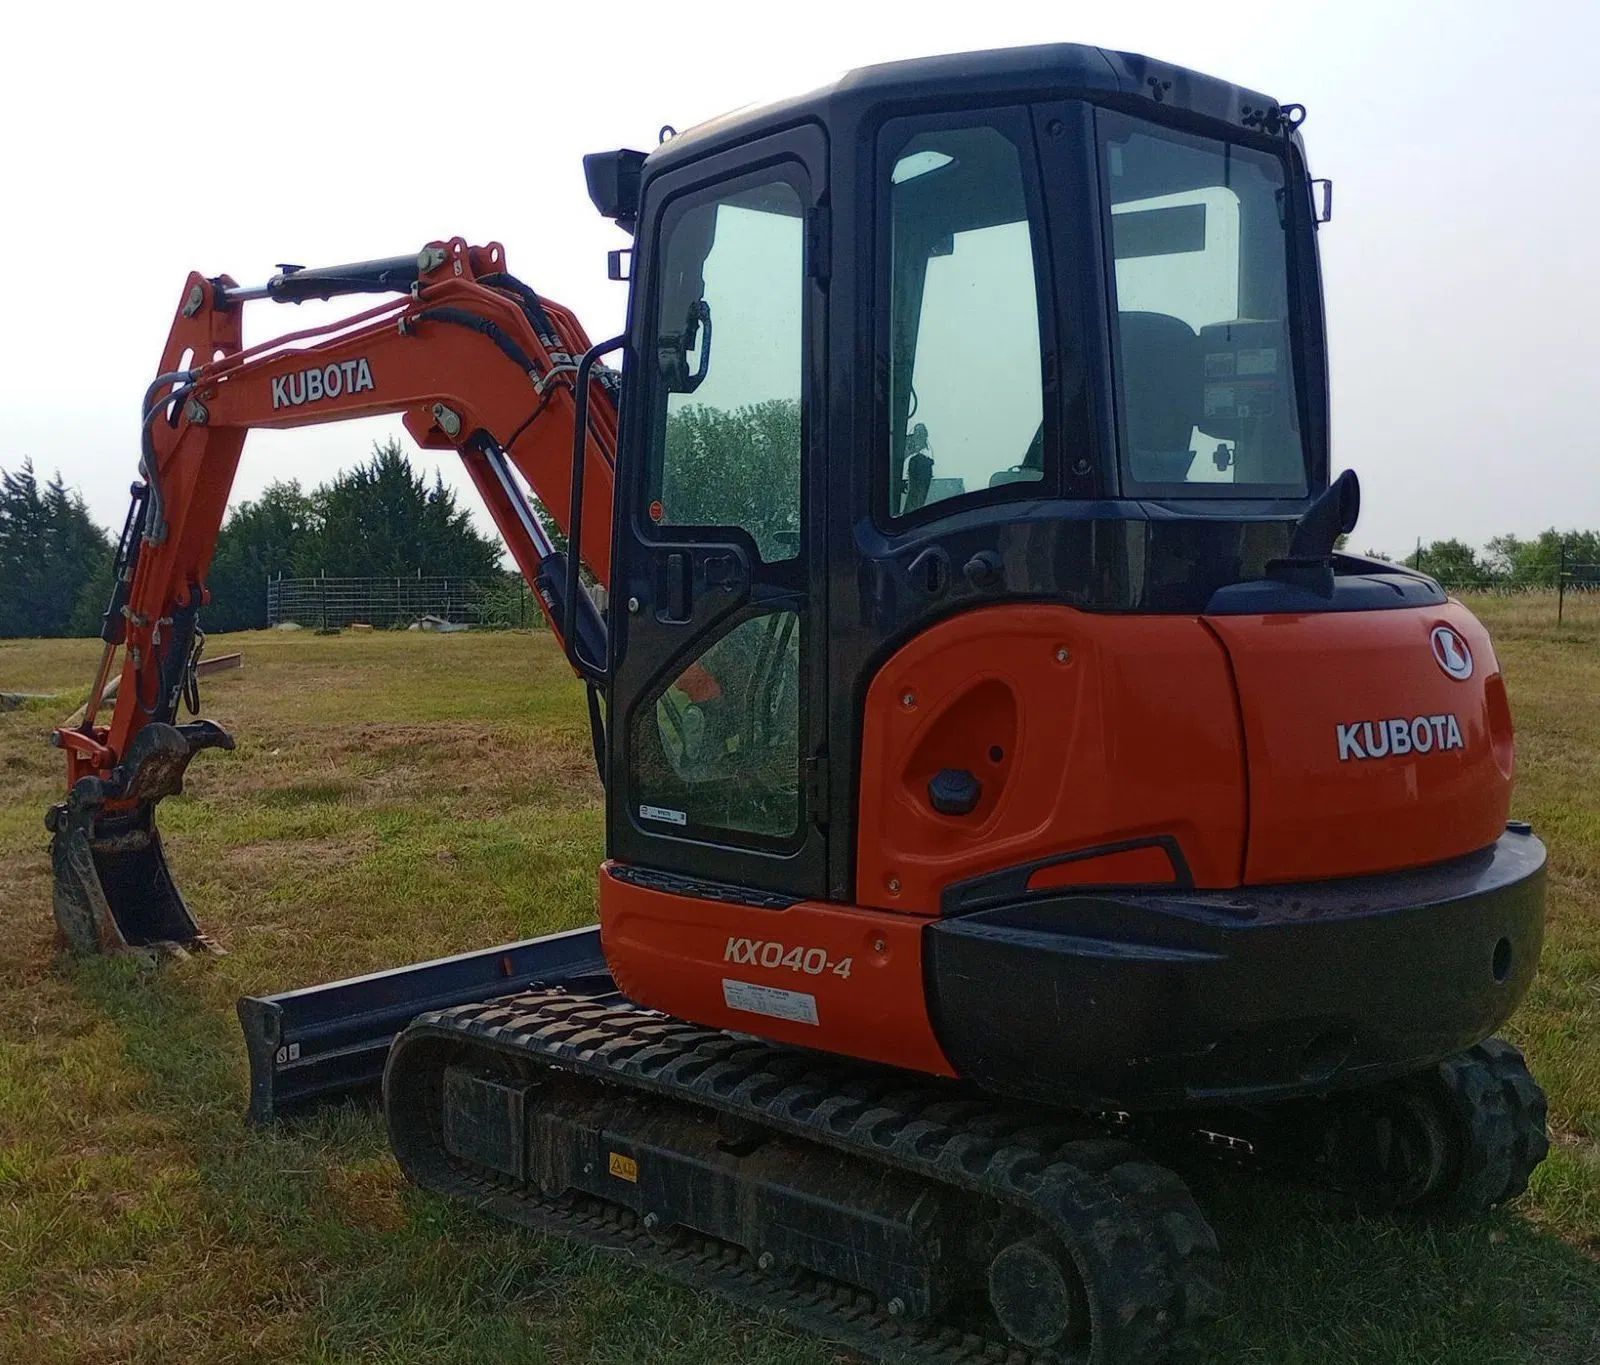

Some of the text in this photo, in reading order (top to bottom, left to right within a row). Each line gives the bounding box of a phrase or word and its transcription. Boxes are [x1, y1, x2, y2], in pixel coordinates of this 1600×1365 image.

[271, 357, 374, 409] KUBOTA
[1336, 714, 1464, 760] KUBOTA
[723, 936, 853, 979] KX040-4
